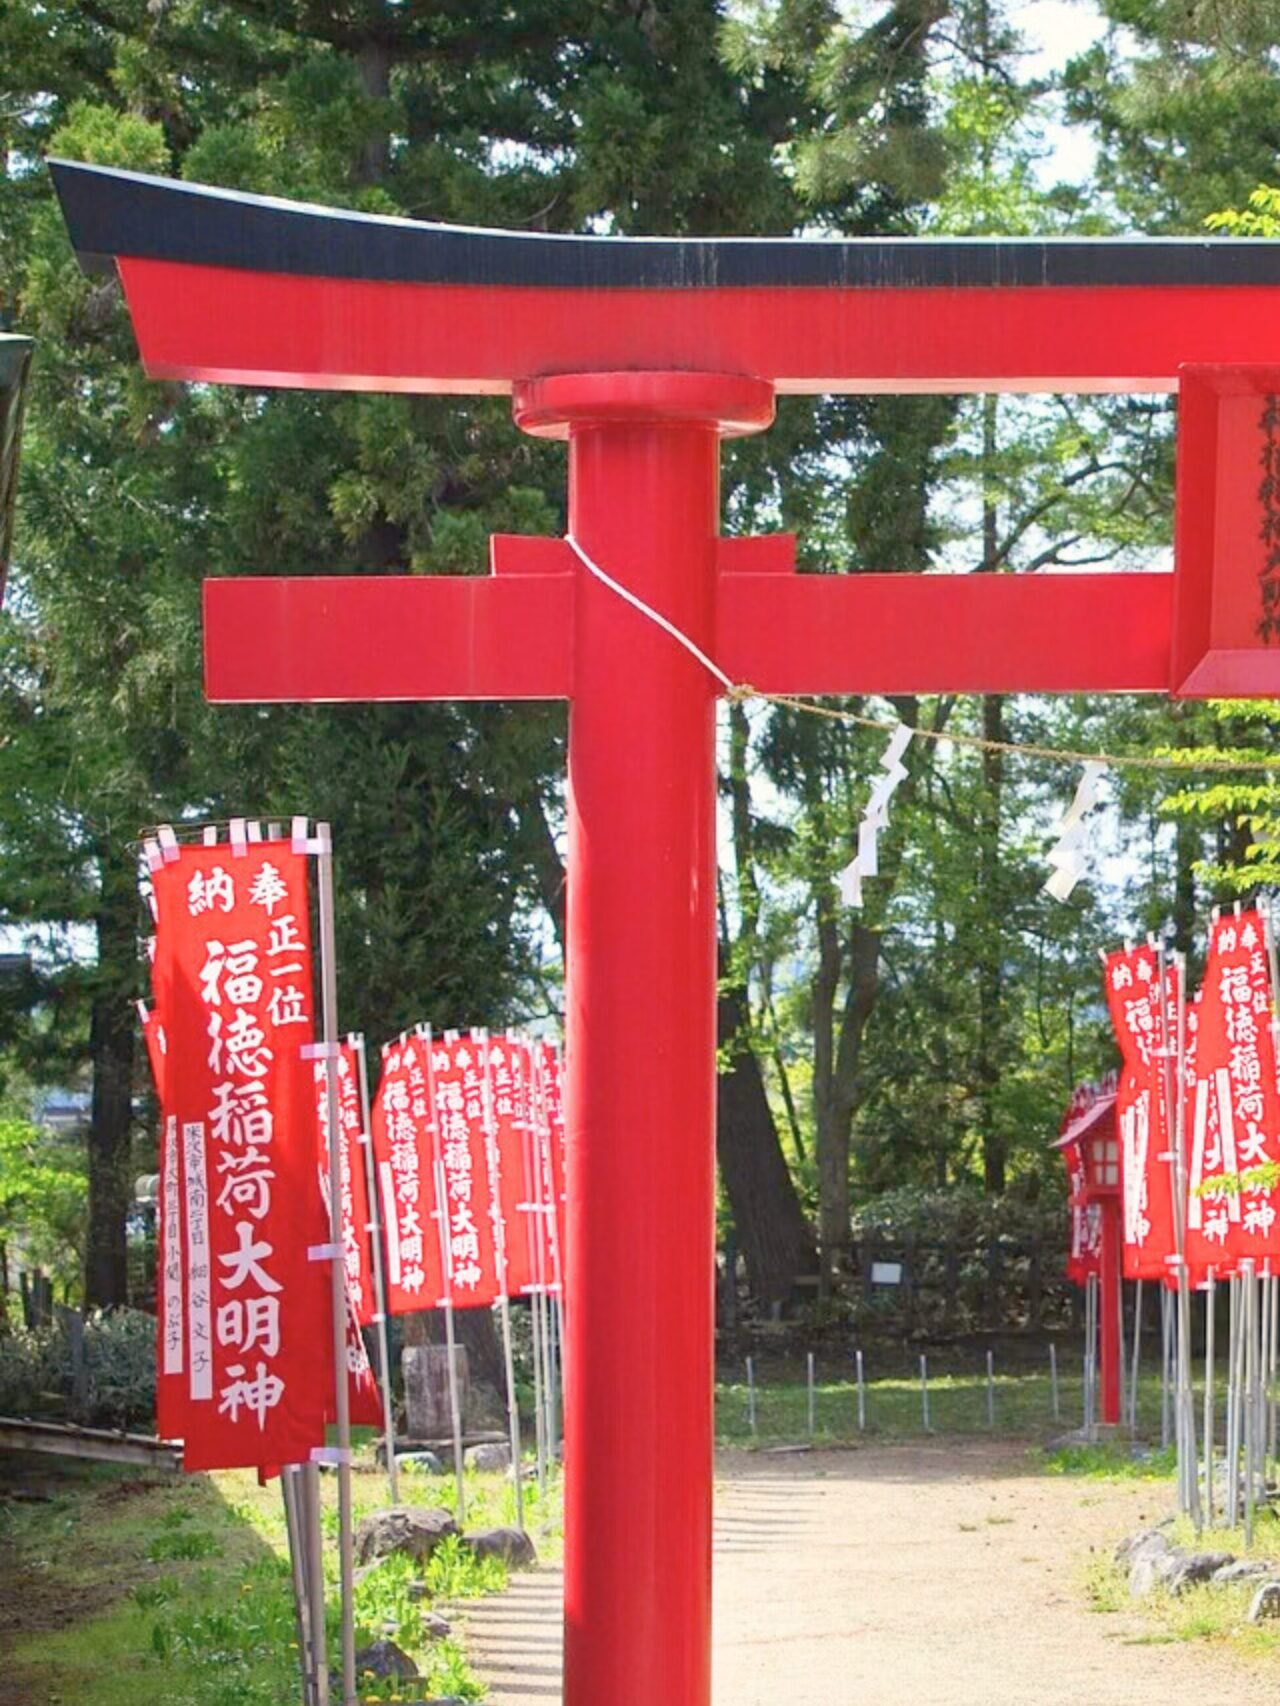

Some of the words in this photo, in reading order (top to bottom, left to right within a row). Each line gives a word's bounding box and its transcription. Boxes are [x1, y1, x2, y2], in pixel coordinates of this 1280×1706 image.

[265, 914, 309, 1027] 正一位
[1250, 951, 1269, 1015] 正一位
[408, 1066, 427, 1118] 正一位
[463, 1068, 483, 1121] 正一位
[199, 939, 285, 1433] 福徳稲荷大明神
[383, 1080, 426, 1296] 福徳稲荷大明神
[436, 1080, 482, 1291] 福徳稲荷大明神
